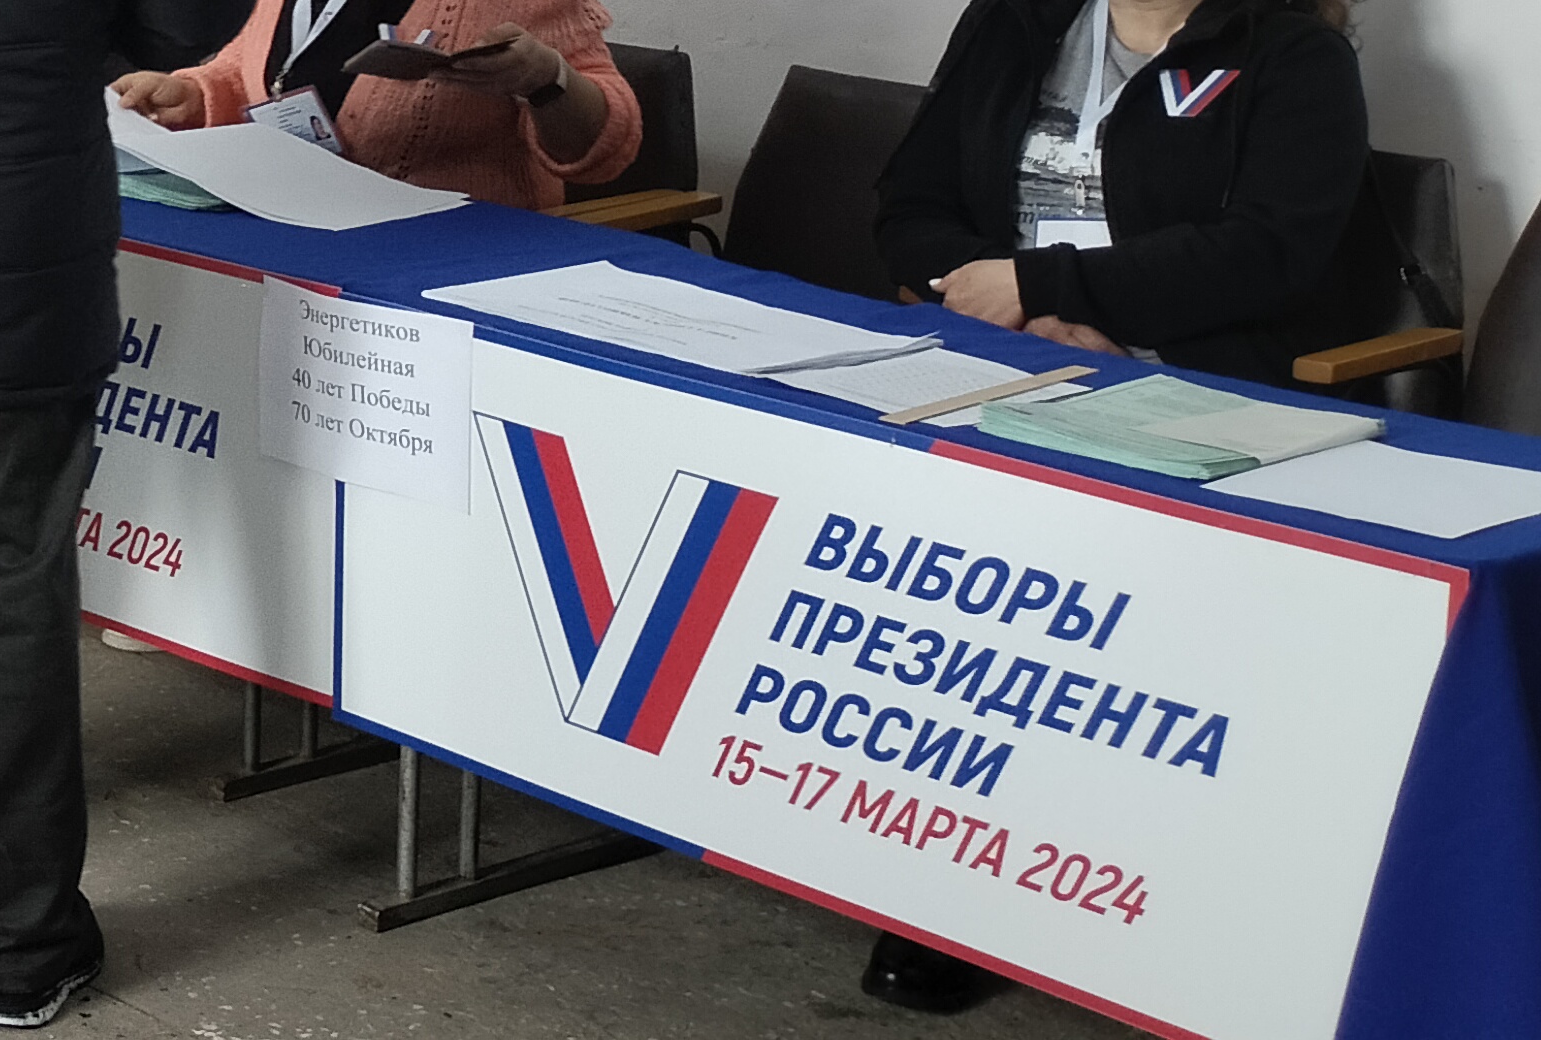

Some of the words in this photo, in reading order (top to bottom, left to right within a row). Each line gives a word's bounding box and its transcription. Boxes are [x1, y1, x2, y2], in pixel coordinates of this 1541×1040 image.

[299, 299, 421, 343] Энергетиков
[303, 335, 415, 378] Юбилейная
[93, 380, 220, 459] ДЕНТА
[292, 367, 312, 390] 40
[315, 379, 345, 399] лет
[350, 383, 430, 417] Победы
[291, 400, 311, 424] 70
[314, 413, 344, 434] лет
[349, 418, 433, 456] Октября
[107, 520, 183, 578] 2024
[804, 512, 1132, 651] ВЫБОРЫ
[767, 588, 1231, 779] ПРЕЗИДЕНТА
[734, 663, 1015, 798] РОССИИ
[840, 779, 1011, 878] МАРТА
[1015, 842, 1149, 926] 2024
